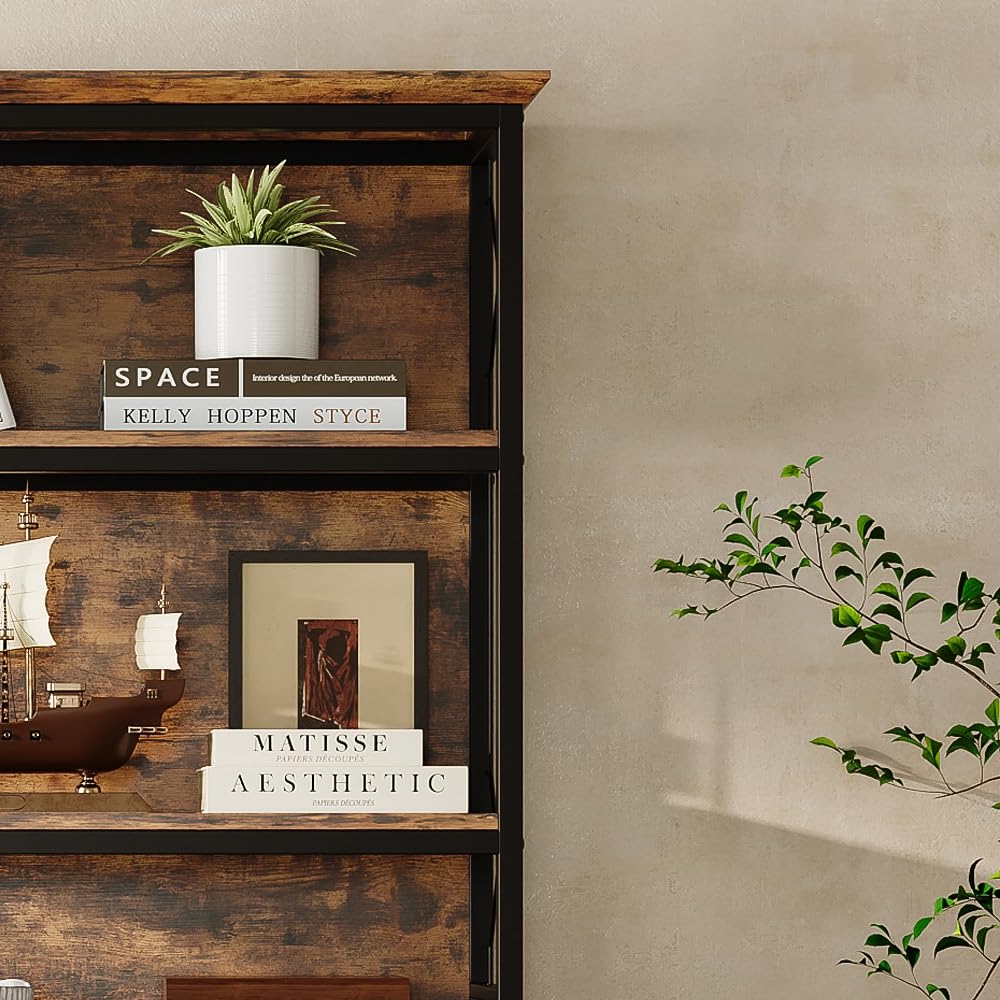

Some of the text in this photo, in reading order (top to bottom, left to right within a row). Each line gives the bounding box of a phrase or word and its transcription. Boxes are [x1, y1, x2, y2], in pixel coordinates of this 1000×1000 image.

[114, 366, 221, 388] SPACE
[252, 373, 398, 384] Interior design the of the European network.
[123, 408, 381, 424] KELLY HOPPEN STYCE
[253, 734, 388, 752] MATISSE
[275, 753, 365, 763] PAPIERS DÉCOUPÉS
[231, 772, 446, 793] AESTHETIC
[312, 799, 339, 807] PAPIERS
